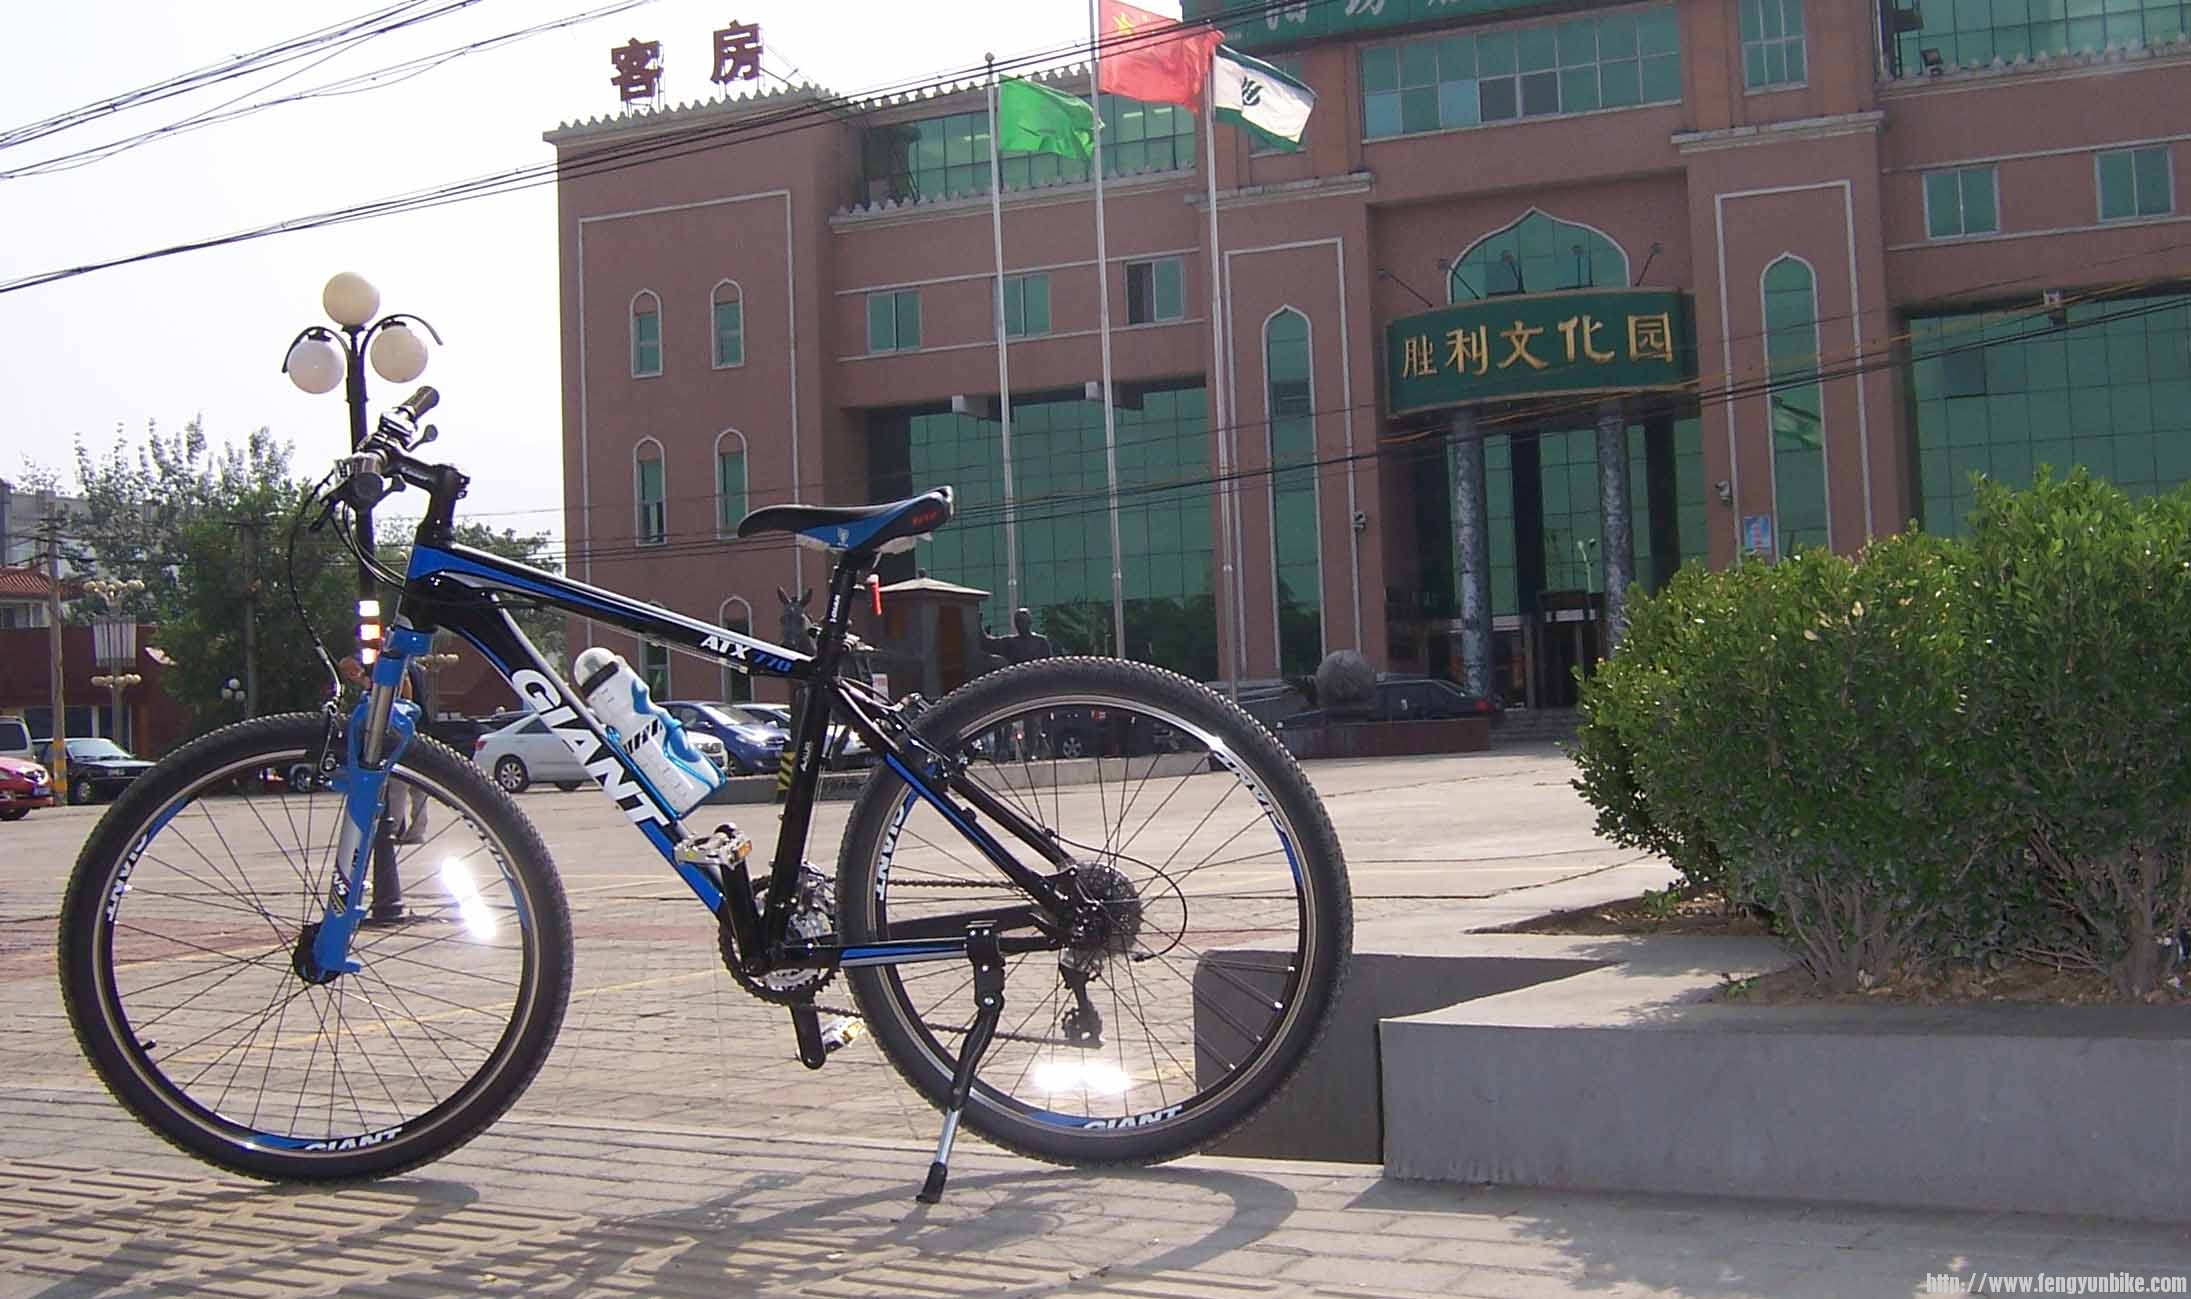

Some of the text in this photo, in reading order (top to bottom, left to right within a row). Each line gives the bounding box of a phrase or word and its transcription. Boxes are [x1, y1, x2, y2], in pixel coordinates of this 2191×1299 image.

[610, 19, 763, 101] 客房
[1402, 311, 1673, 378] 胜利文化园
[700, 634, 793, 673] ATX 770
[511, 668, 671, 827] GIANT
